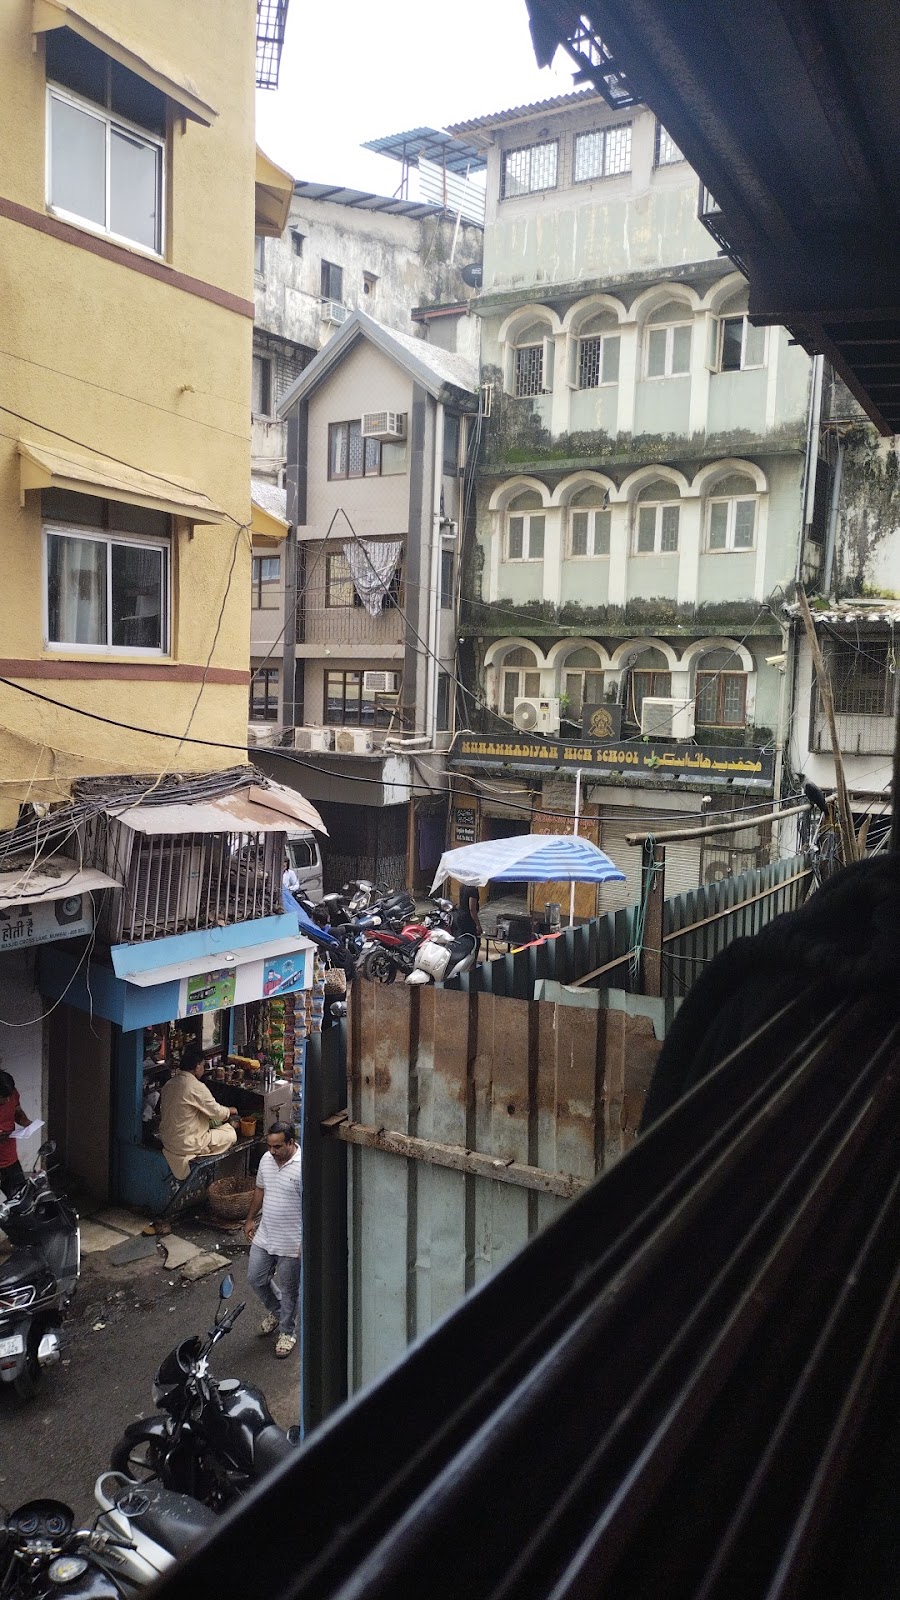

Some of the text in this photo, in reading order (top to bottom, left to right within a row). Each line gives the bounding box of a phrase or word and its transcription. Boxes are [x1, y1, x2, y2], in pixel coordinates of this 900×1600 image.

[462, 741, 639, 764] MUHAMMADIYAH HIGH SCHOOL
[1, 918, 34, 941] होती है
